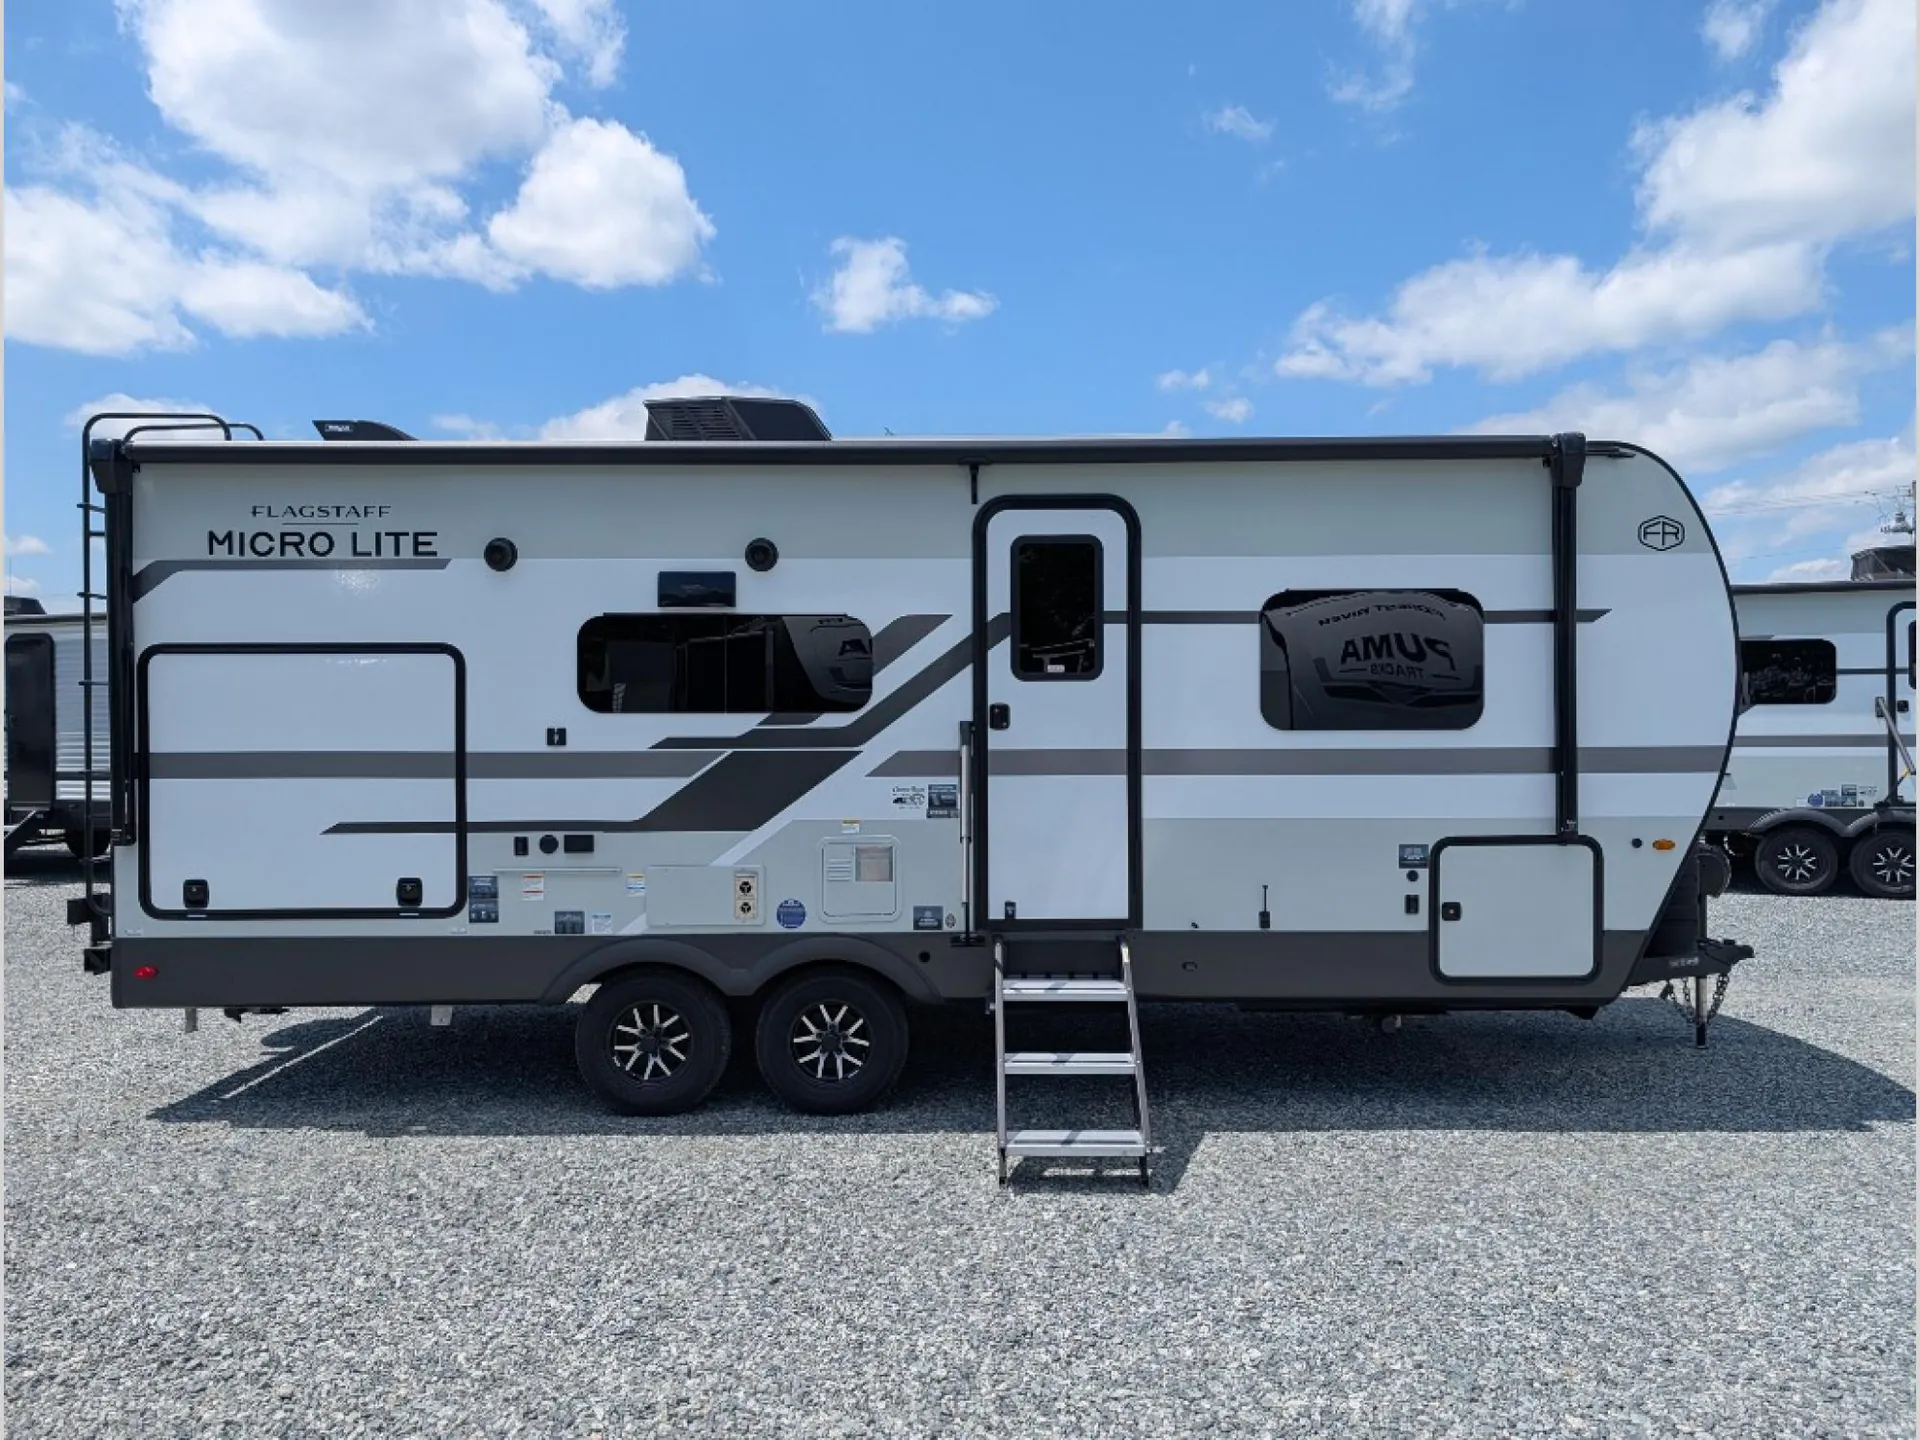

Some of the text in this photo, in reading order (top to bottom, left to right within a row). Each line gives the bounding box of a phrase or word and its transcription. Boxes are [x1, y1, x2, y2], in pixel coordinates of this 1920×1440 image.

[250, 504, 392, 519] FLAGSTAFF
[207, 529, 438, 558] MICRO LITE
